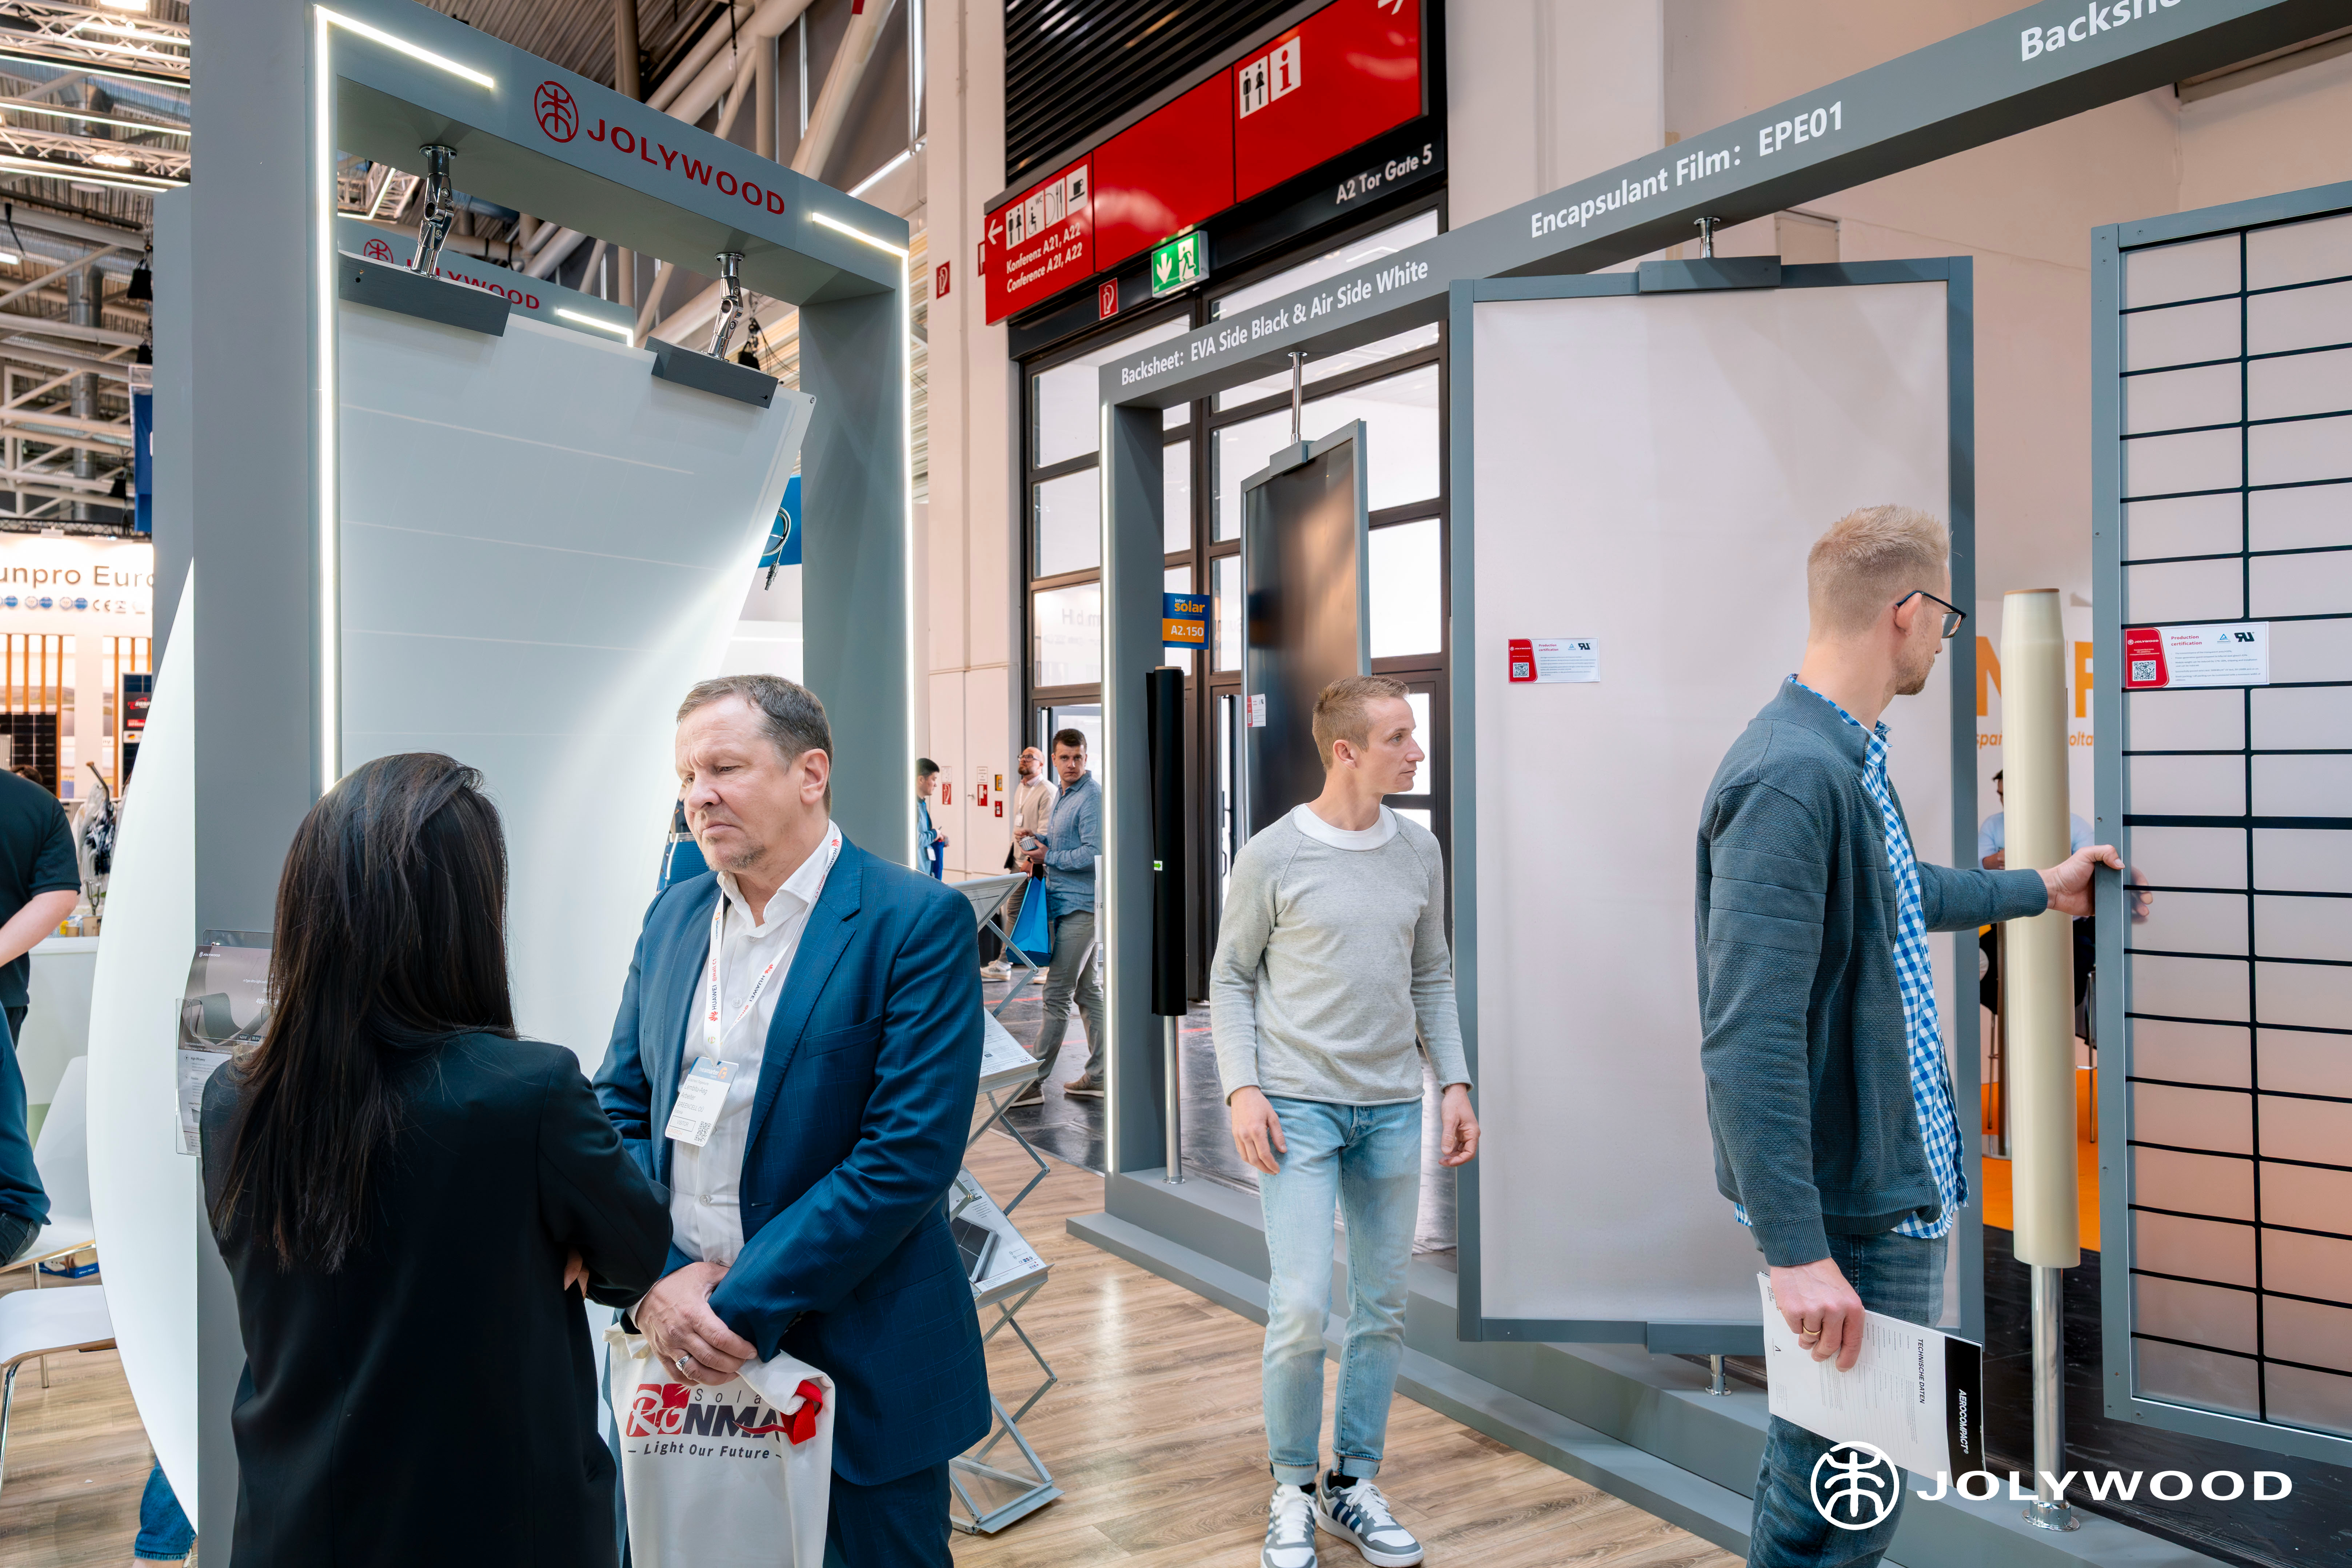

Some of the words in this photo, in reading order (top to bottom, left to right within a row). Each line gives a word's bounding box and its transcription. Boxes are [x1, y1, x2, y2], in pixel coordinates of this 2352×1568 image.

[587, 119, 784, 215] JOLYWOOD
[1336, 180, 1356, 204] A2
[1359, 173, 1381, 193] Tor
[1385, 156, 1419, 181] Gate
[1422, 143, 1432, 165] 5
[1532, 167, 1668, 238] Encapsulant
[1676, 145, 1741, 186] Film:
[1759, 100, 1842, 156] EPE01
[1006, 248, 1042, 274] Konferenz
[1043, 234, 1062, 254] A21,
[1063, 222, 1081, 243] A22
[1007, 266, 1045, 293] Conference
[1047, 252, 1064, 273] A21,
[1065, 242, 1082, 263] A22
[1122, 350, 1184, 386] Backsheet:
[1191, 338, 1215, 362] EVA
[1219, 330, 1247, 351] Side
[1252, 308, 1288, 340] Black
[1293, 303, 1306, 324] &
[1310, 296, 1333, 319] Air
[1337, 279, 1371, 308] Side
[1376, 260, 1428, 294] White
[1174, 601, 1205, 613] solar
[1171, 625, 1203, 637] A2.150
[826, 847, 837, 872] HUAWEI
[749, 975, 765, 1002] HUAWEI
[680, 1092, 696, 1100] Arbeiter
[684, 1084, 708, 1095] Lembitu-Aeg
[677, 1101, 697, 1111] GREENCELL
[695, 1388, 761, 1404] Sola
[644, 1441, 684, 1455] Light
[689, 1444, 714, 1456] Our
[720, 1446, 770, 1459] Future
